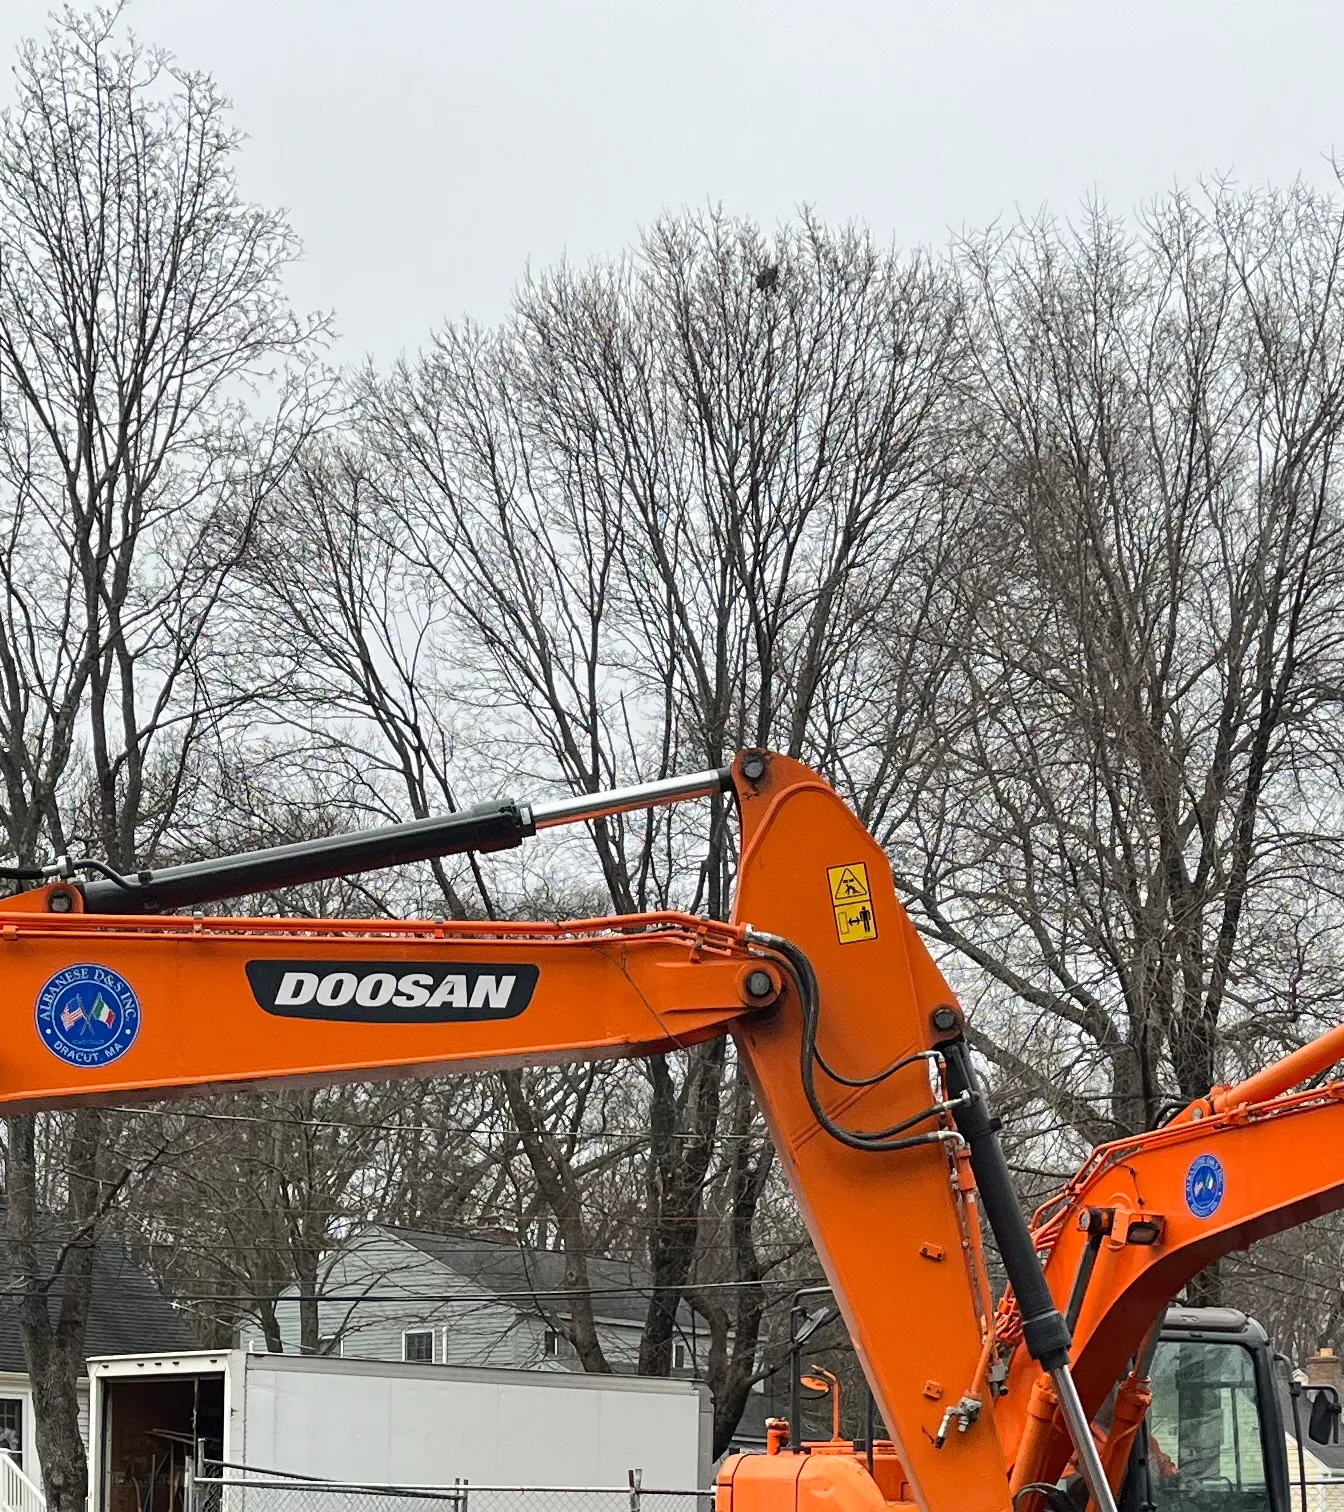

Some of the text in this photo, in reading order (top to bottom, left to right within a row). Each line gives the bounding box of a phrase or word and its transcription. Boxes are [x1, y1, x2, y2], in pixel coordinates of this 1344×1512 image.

[39, 968, 89, 1021] ALBANESE
[93, 969, 124, 992] D&S
[274, 972, 516, 1008] DOOSAN
[104, 1042, 124, 1058] MA
